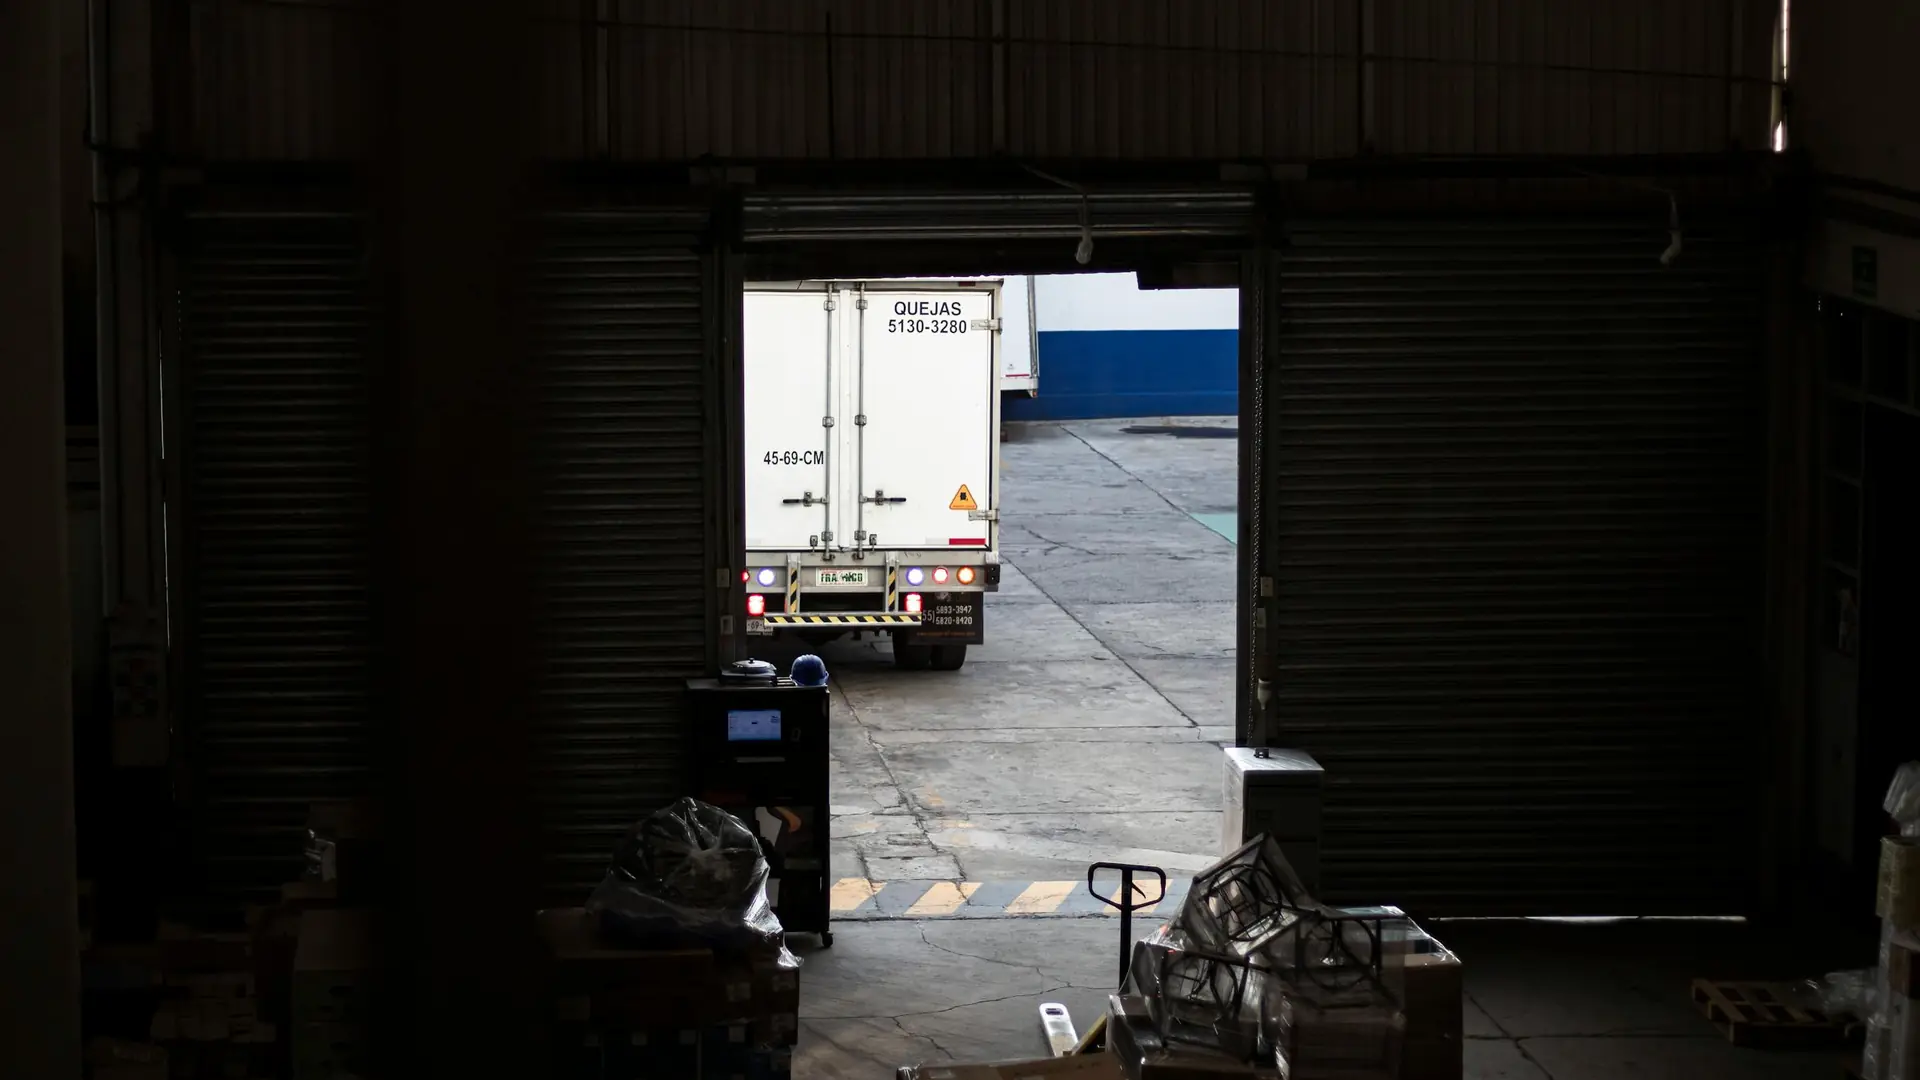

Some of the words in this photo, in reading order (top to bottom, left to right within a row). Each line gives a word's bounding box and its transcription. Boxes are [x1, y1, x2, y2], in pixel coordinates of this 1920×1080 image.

[894, 301, 962, 316] QUEJAS
[888, 319, 967, 333] 5130-3280
[763, 451, 825, 465] 45-69-CM
